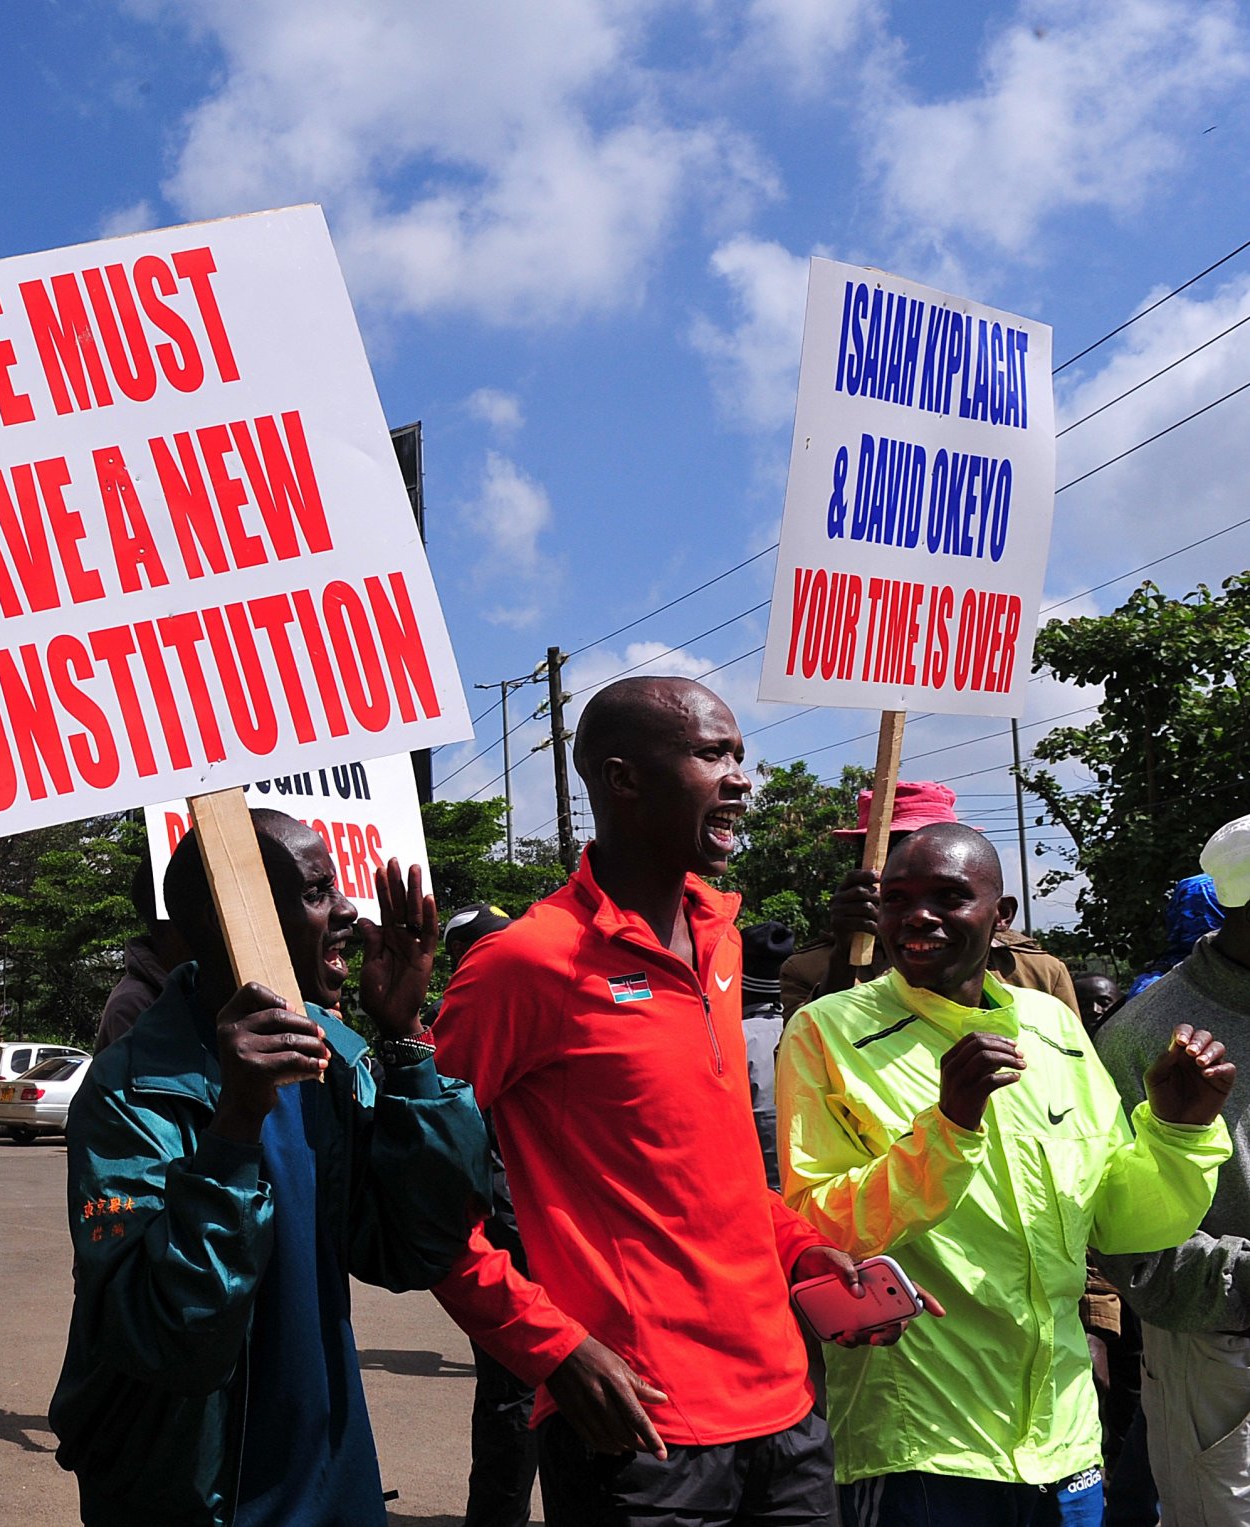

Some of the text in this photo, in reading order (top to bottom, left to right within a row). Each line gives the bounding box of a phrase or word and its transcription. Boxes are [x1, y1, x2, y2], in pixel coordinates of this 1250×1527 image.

[19, 247, 240, 415] MUST
[836, 281, 1028, 429] ISAIAH KIPLAGAT
[92, 446, 169, 593] A
[149, 410, 333, 579] NEW
[828, 434, 1012, 562] & DAVID OKEYO
[786, 568, 1021, 693] YOUR TIME IS OVER
[1067, 1470, 1102, 1493] adidas
